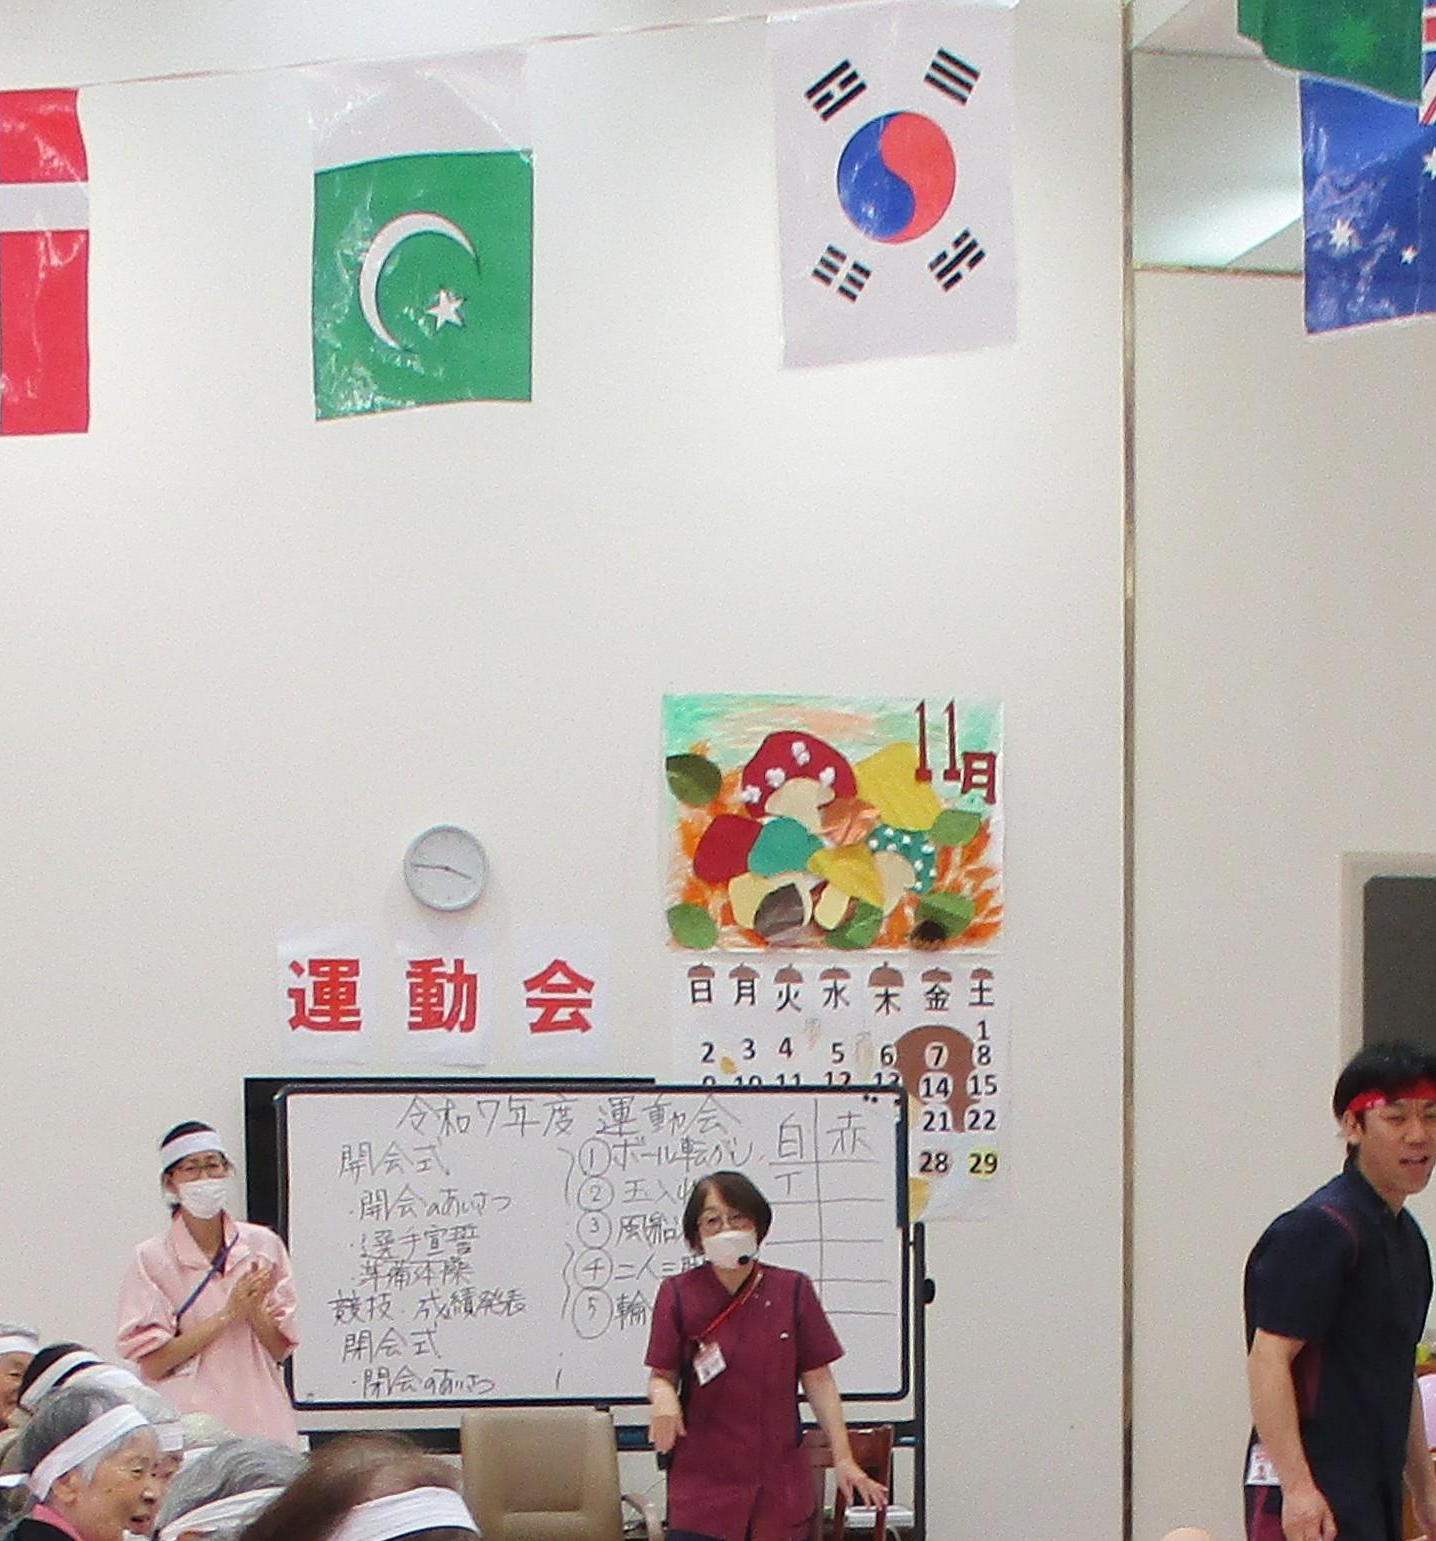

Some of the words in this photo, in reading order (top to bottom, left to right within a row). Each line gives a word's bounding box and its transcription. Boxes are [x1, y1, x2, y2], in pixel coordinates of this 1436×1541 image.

[915, 699, 996, 804] 11月
[287, 958, 596, 1034] 運動会
[691, 979, 712, 1004] 日
[734, 979, 756, 1006] 月
[776, 983, 802, 1012] 火
[823, 981, 850, 1010] 水
[875, 987, 901, 1016] 木
[924, 984, 950, 1012] 金
[969, 979, 994, 1007] 土
[977, 1020, 990, 1040] 1
[701, 1042, 715, 1063] 2
[743, 1038, 756, 1060] 3
[778, 1037, 793, 1058] 4
[831, 1042, 845, 1063] 5
[880, 1044, 894, 1065] 6
[930, 1045, 944, 1066] 7
[977, 1044, 991, 1066] 8
[923, 1077, 949, 1098] 14
[969, 1074, 997, 1096] 15
[826, 1110, 873, 1156] 赤
[923, 1111, 950, 1132] 21
[968, 1109, 996, 1130] 22
[919, 1151, 948, 1173] 28
[969, 1152, 998, 1174] 29
